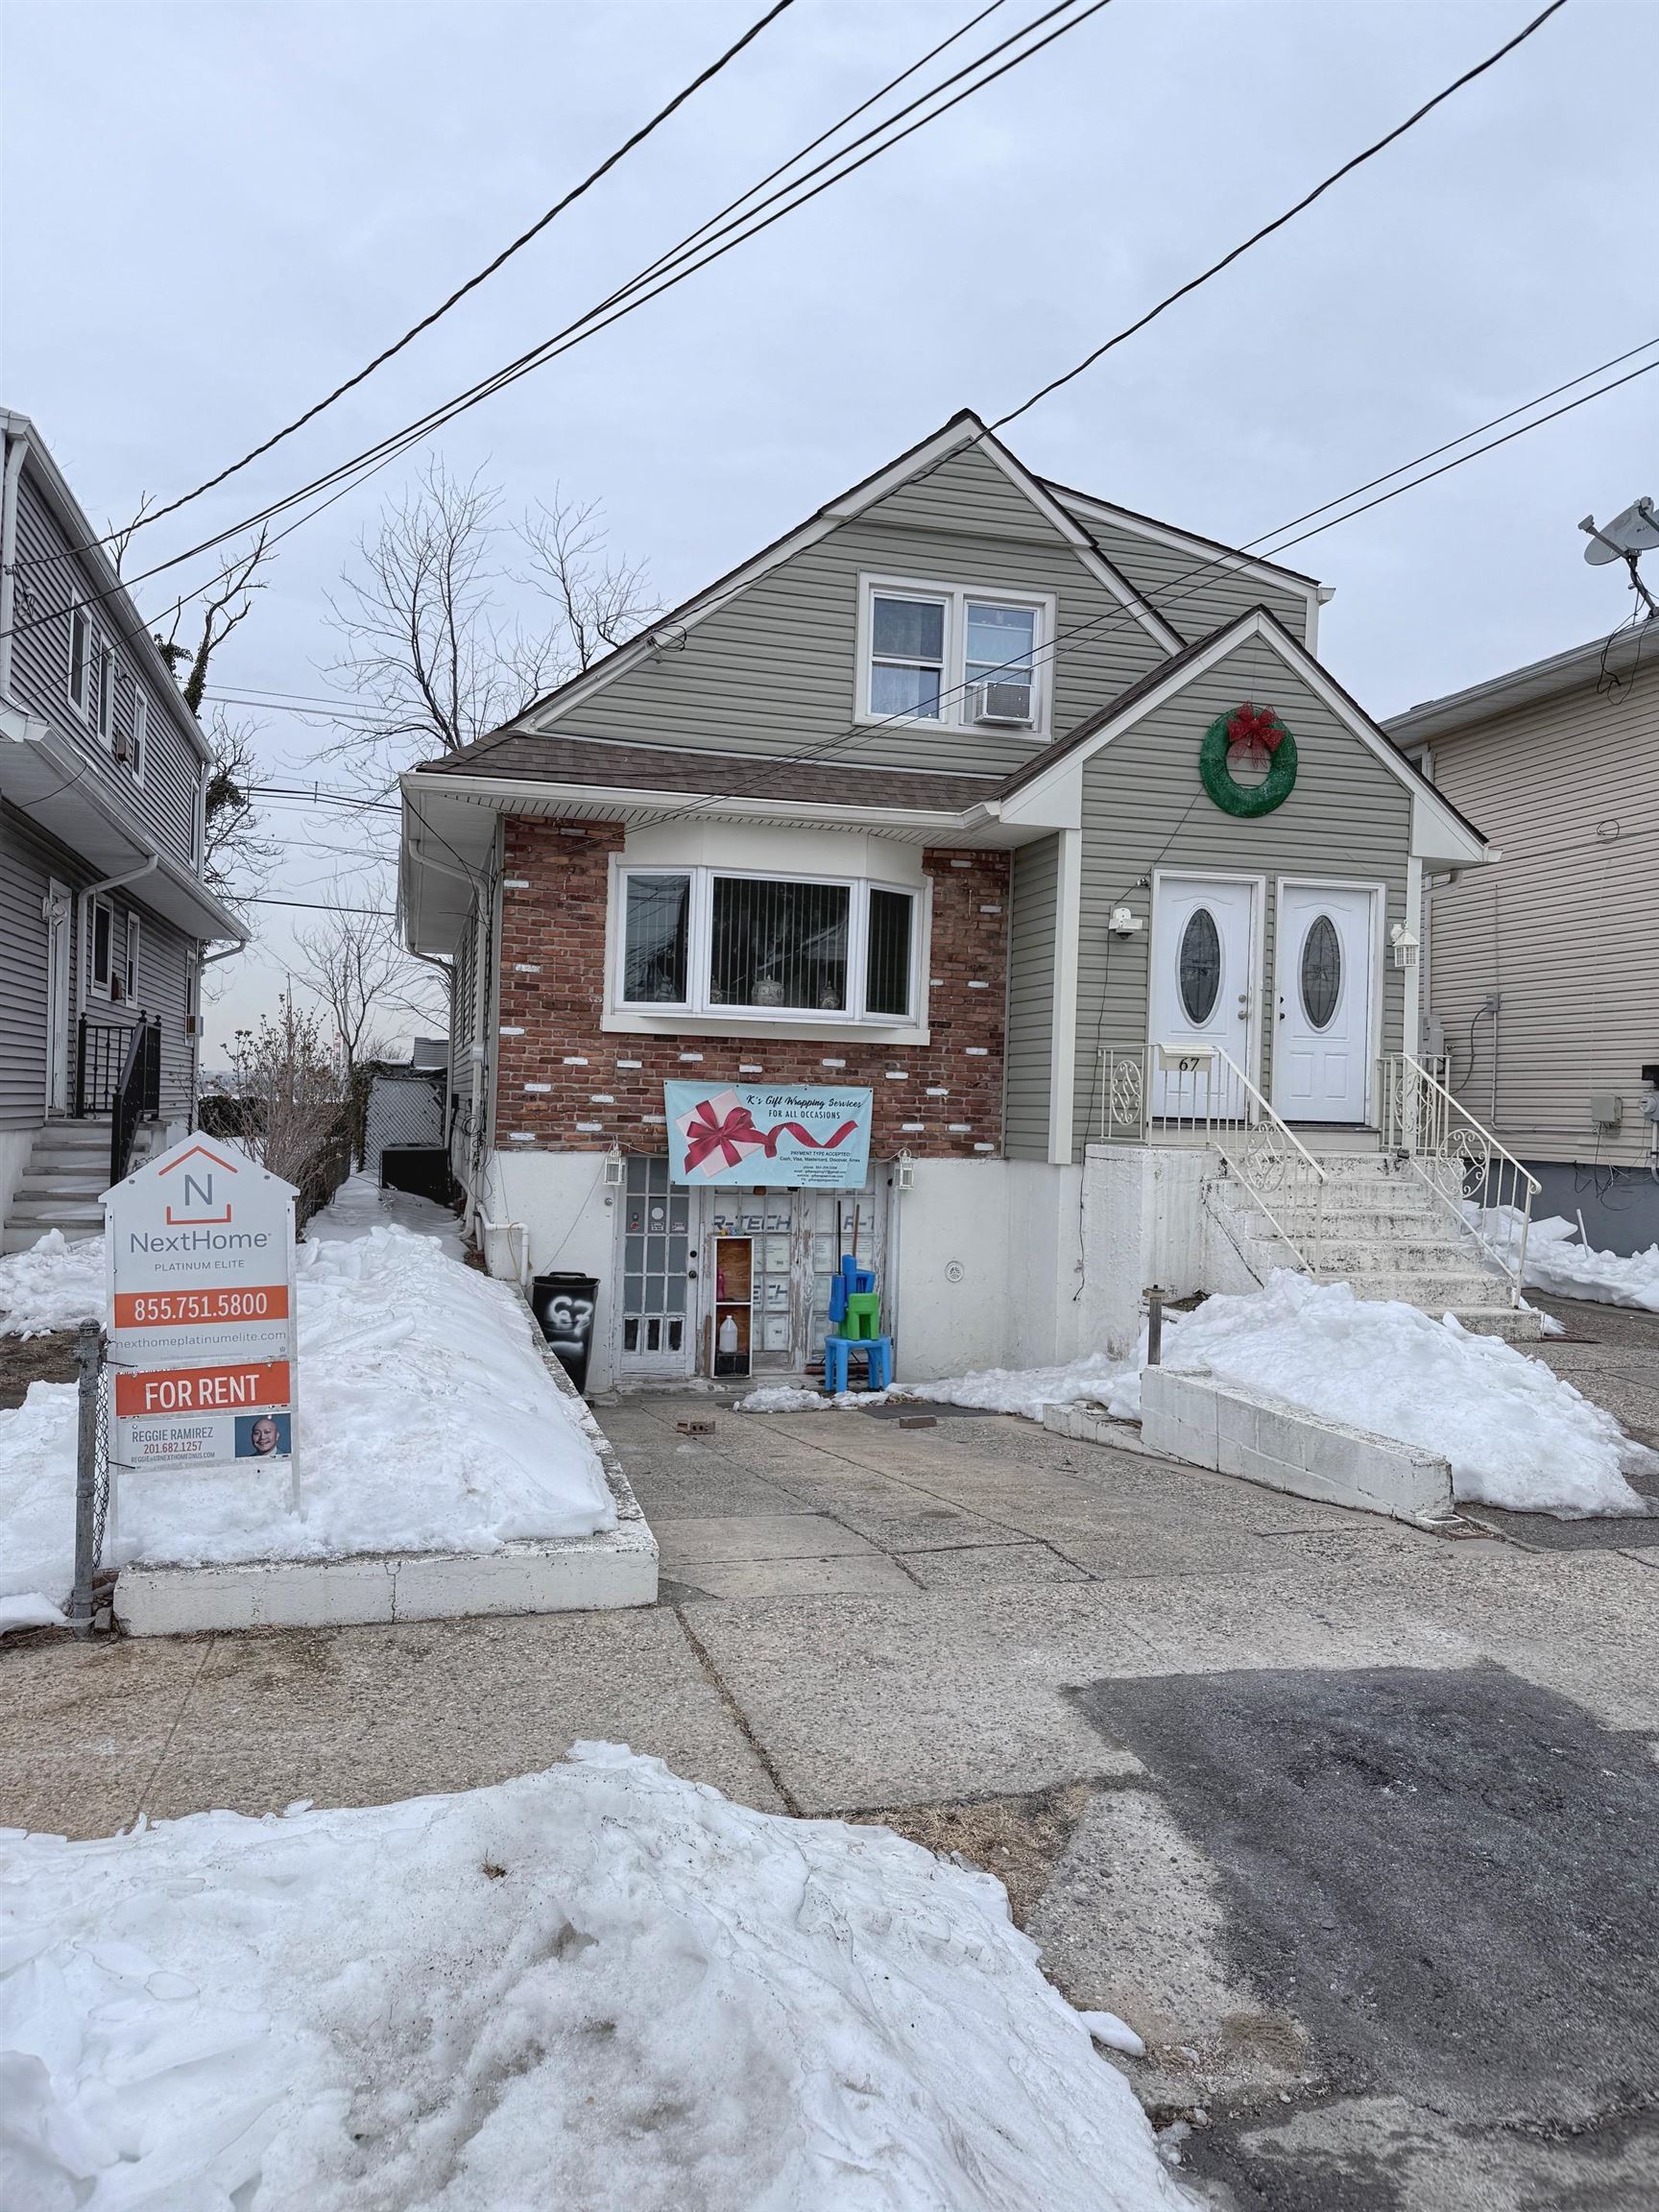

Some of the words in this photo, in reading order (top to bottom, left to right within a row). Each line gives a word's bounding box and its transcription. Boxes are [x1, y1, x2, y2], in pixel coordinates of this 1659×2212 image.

[1179, 1057, 1200, 1071] 67
[765, 1095, 781, 1108] Gift
[784, 1095, 825, 1110] Wrapping
[828, 1098, 862, 1108] Services
[768, 1109, 782, 1118] FOR
[785, 1110, 798, 1118] ALL
[801, 1111, 841, 1119] OCCASIONS
[184, 1173, 213, 1206] N
[131, 1230, 268, 1253] NextHome
[155, 1262, 211, 1272] PLATINUM
[214, 1260, 246, 1269] ELITE
[134, 1292, 268, 1321] 855.751.5800
[116, 1331, 286, 1349] nexthomeplatinumelite.com
[145, 1380, 193, 1410] FOR
[199, 1374, 260, 1405] RENT
[132, 1429, 168, 1442] REGGIE
[171, 1427, 213, 1441] RAMIREZ
[144, 1441, 203, 1455] 201.682.1257
